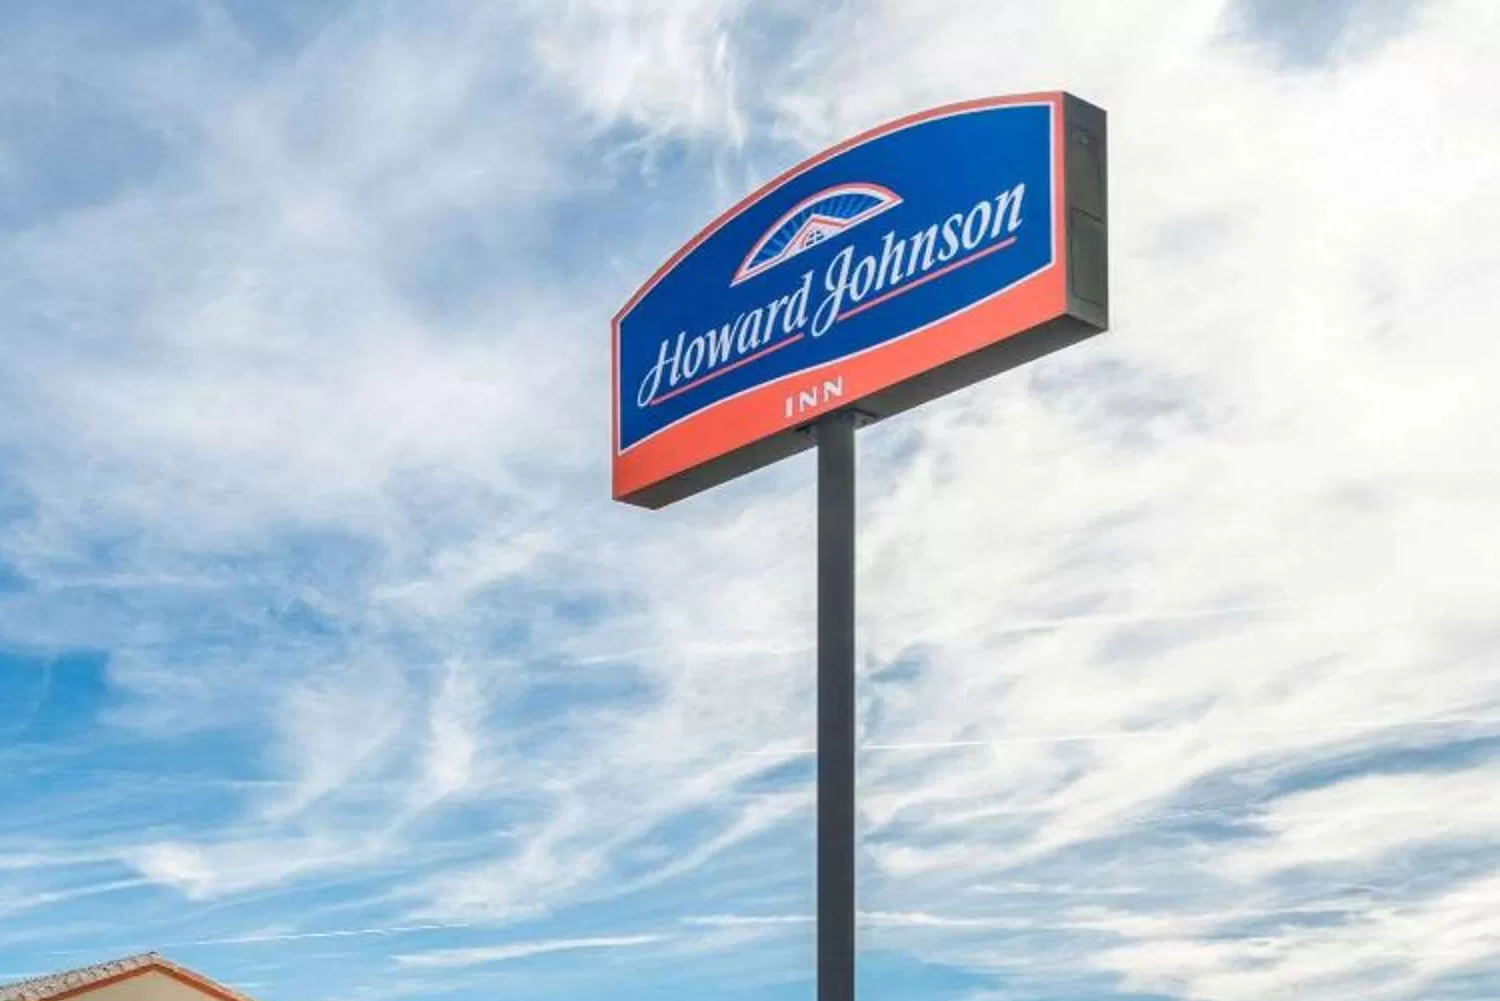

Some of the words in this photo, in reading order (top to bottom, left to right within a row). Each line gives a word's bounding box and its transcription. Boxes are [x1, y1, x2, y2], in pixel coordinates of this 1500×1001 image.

[638, 275, 810, 408] Howard
[812, 183, 1025, 337] Johnson
[785, 376, 844, 417] INN
